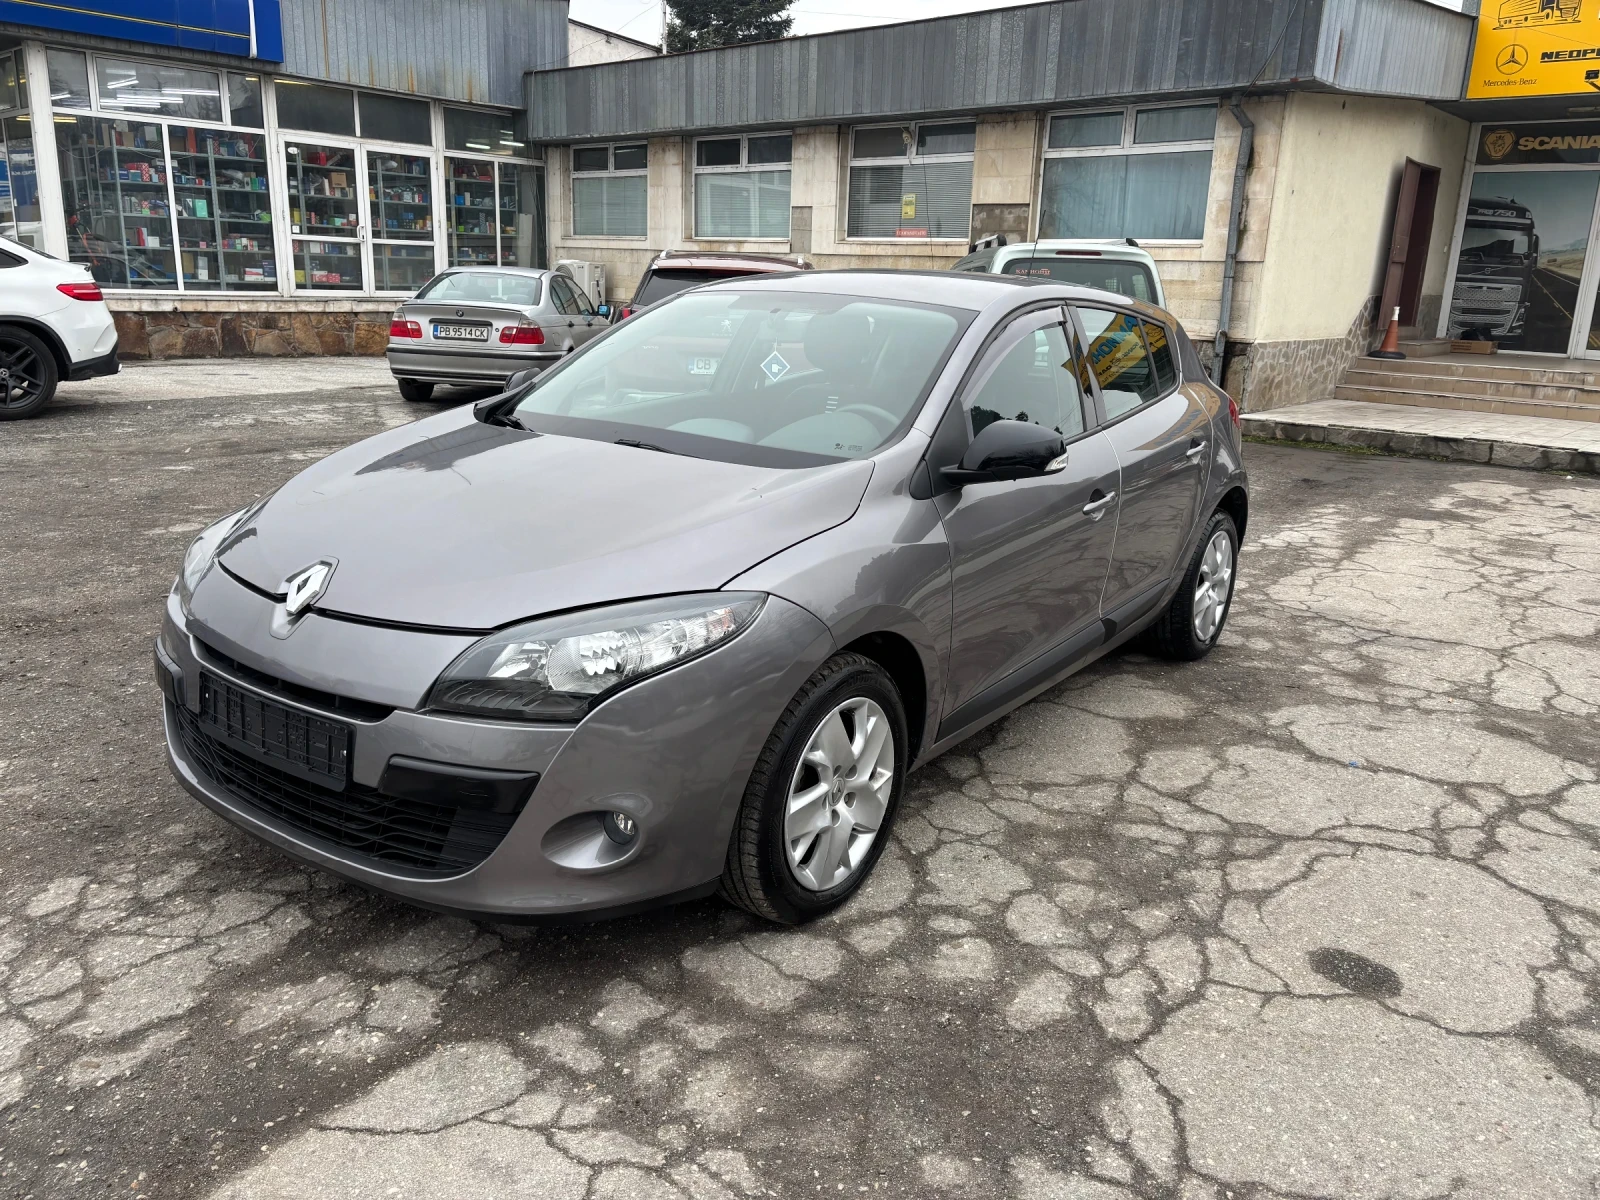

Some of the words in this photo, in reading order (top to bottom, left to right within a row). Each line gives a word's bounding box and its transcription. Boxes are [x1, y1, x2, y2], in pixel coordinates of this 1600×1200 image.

[1482, 78, 1538, 88] Mercedes-Benz
[1517, 135, 1600, 150] SCANIA
[1494, 209, 1516, 217] 750
[452, 327, 473, 337] 9514
[696, 358, 711, 370] CB
